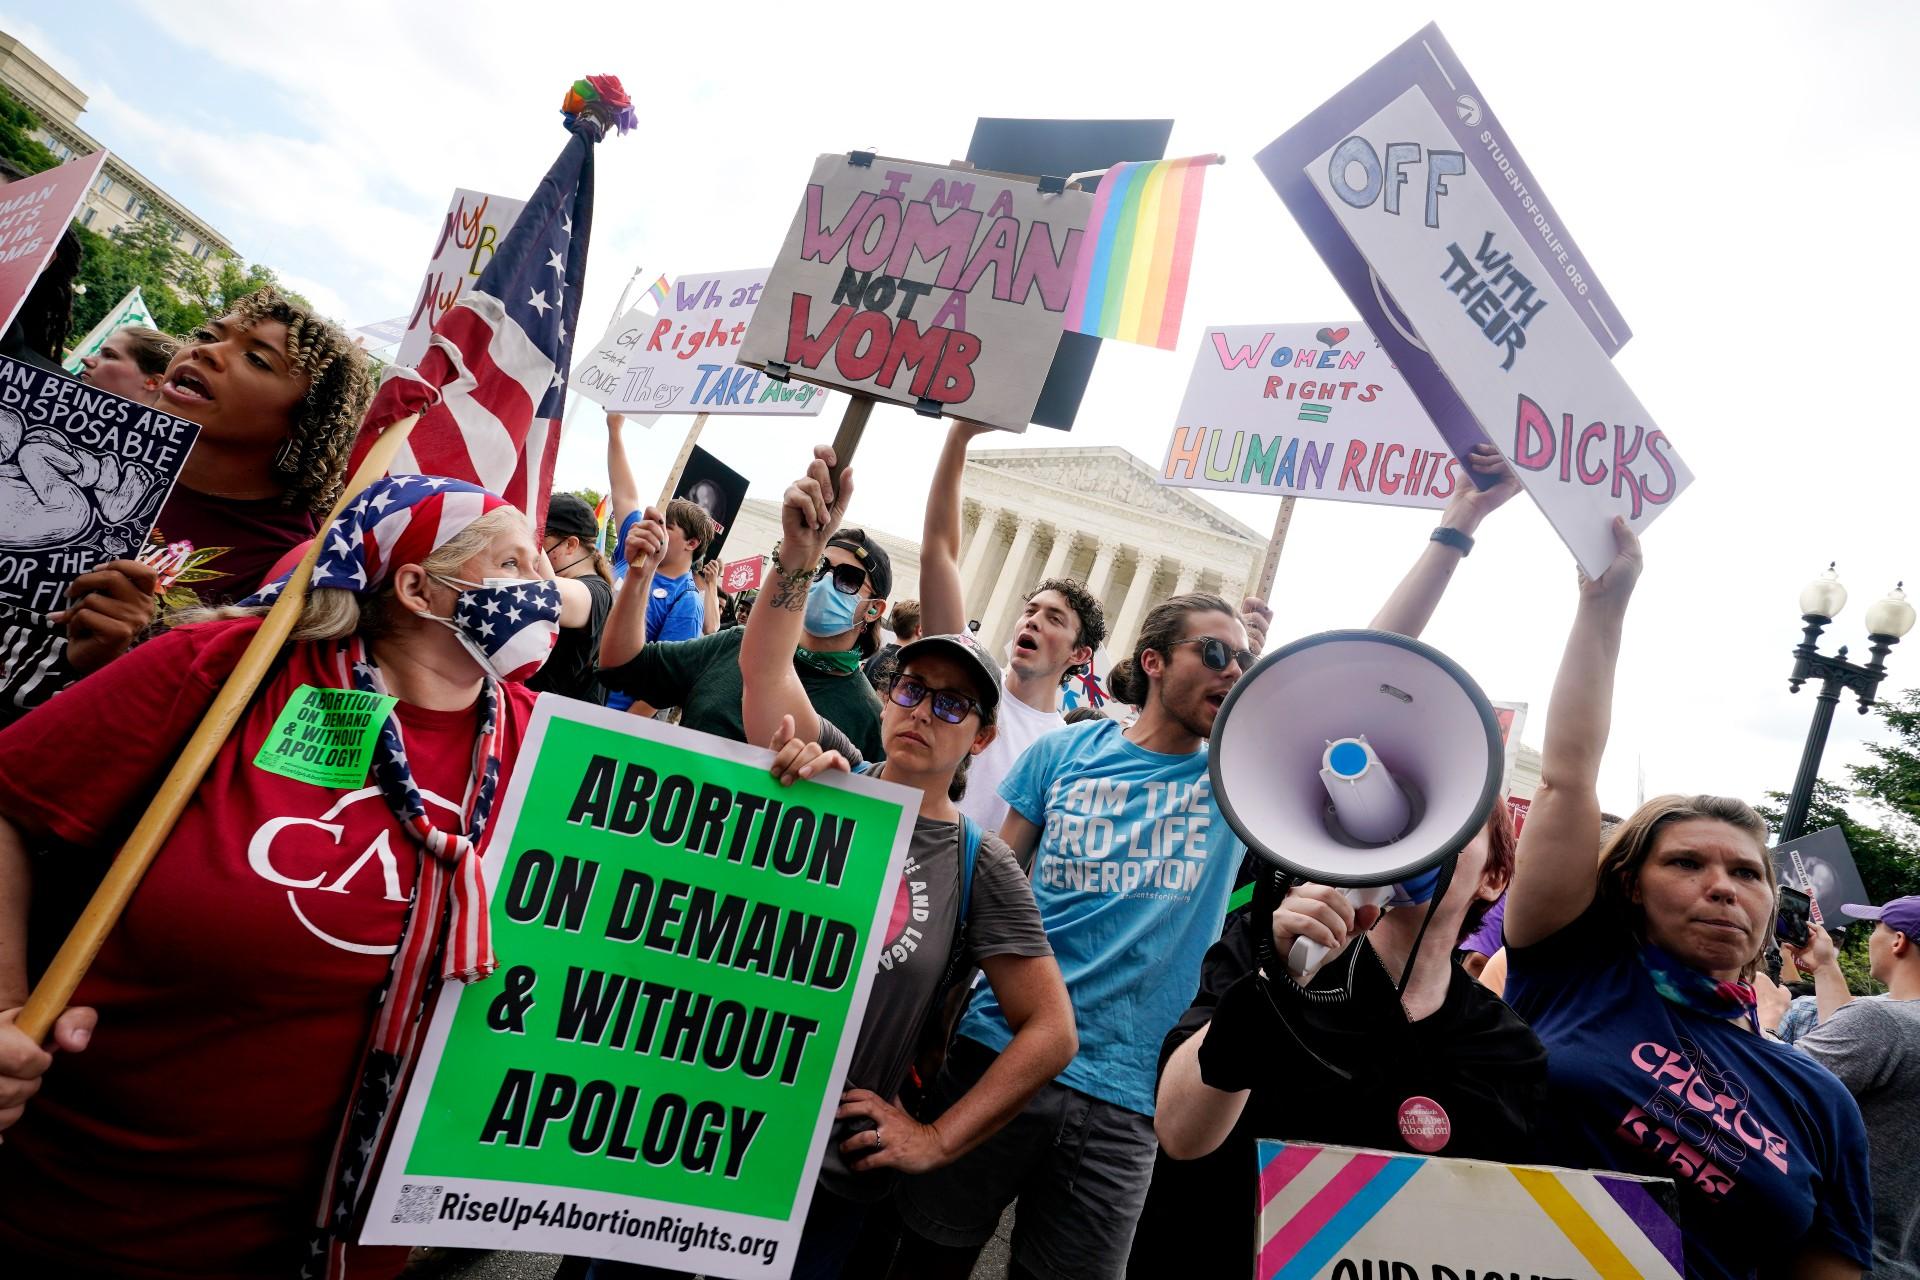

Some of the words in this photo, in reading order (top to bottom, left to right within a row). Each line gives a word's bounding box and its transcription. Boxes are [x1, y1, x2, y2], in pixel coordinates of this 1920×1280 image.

[880, 171, 912, 201] I
[925, 178, 976, 208] AM
[987, 189, 1013, 218] A
[1329, 136, 1466, 229] OFF
[432, 196, 489, 261] My
[1479, 130, 1589, 297] STUDENTSFORLIFE.ORG
[468, 224, 504, 278] B
[800, 183, 1085, 312] WOMAN
[675, 279, 764, 312] What
[831, 266, 934, 320] NOT
[931, 289, 967, 332] A
[1475, 230, 1548, 329] WITH
[1440, 241, 1526, 373] THEIR
[784, 291, 982, 404] WOMB
[1211, 332, 1366, 370] WOMEN
[40, 376, 131, 424] BEINGS
[133, 410, 190, 445] ARE
[622, 366, 684, 409] They
[690, 363, 762, 406] TAKE
[1263, 375, 1383, 402] RIGHTS
[2, 385, 178, 473] DISPOSABLE
[1165, 426, 1334, 491] HUMAN
[1338, 439, 1460, 499] RIGHTS
[1508, 393, 1679, 520] DICKS
[47, 550, 95, 574] THE
[31, 580, 74, 611] FI
[297, 707, 320, 724] ON
[321, 712, 372, 728] DEMAND
[302, 690, 384, 712] ABORTION
[276, 737, 363, 768] APOLOGY!
[283, 721, 297, 737] &
[301, 725, 367, 747] WITHOUT
[566, 753, 857, 889] ABORTION
[1065, 777, 1131, 817] AM
[1142, 773, 1211, 819] THE
[1045, 811, 1211, 860] PRO-LIFE
[1041, 853, 1205, 893] GENERATION
[504, 848, 601, 933] ON
[604, 868, 859, 993] DEMAND
[909, 881, 930, 922] AND
[877, 926, 923, 973] LEGA
[486, 964, 538, 1035] &
[555, 965, 821, 1086] WITHOUT
[478, 1067, 767, 1180] APOLOGY
[1400, 1115, 1416, 1125] Aid
[1424, 1116, 1446, 1125] Abet
[1401, 1124, 1448, 1135] Abortion
[1631, 1042, 1788, 1176] CHOICE
[438, 1192, 779, 1265] RiseUp4AbortionRights.org
